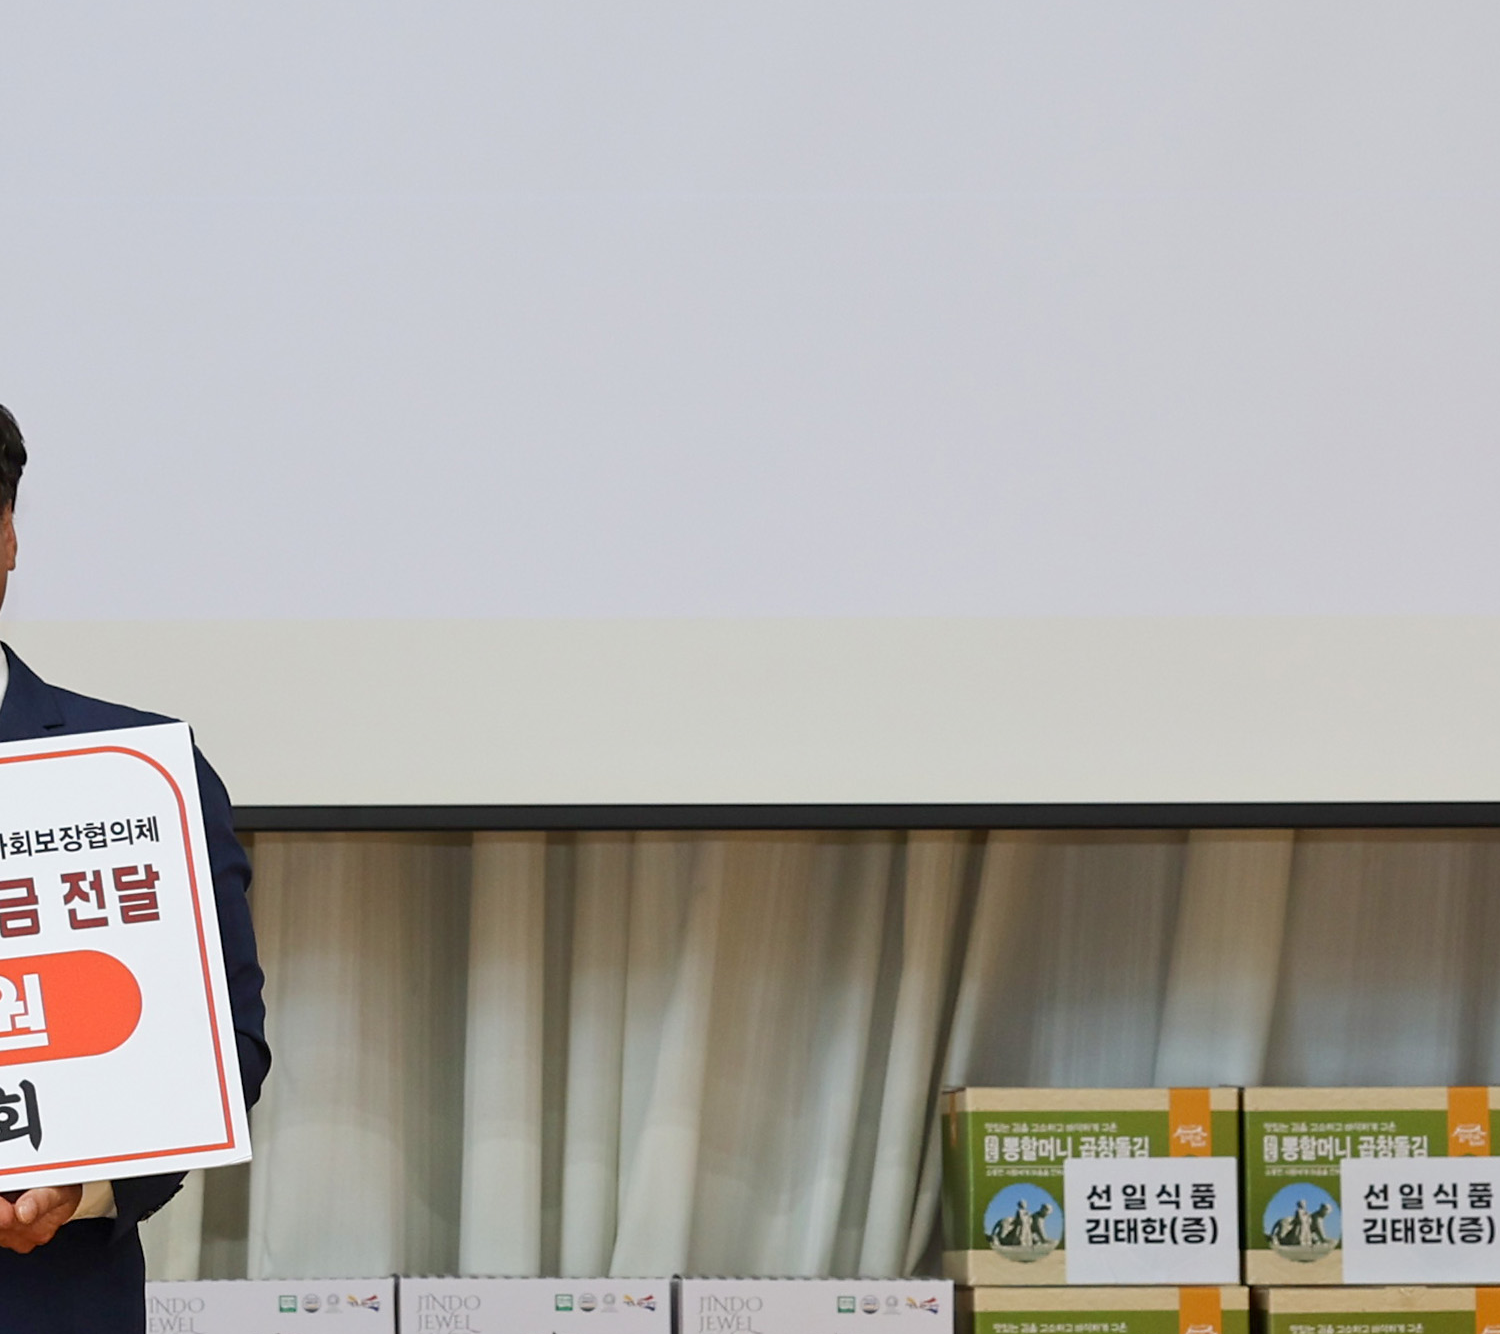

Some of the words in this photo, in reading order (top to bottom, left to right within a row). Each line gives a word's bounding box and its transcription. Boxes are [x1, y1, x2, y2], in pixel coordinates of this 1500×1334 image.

[61, 864, 161, 930] 전달
[1086, 1216, 1217, 1244] 김태한(증)
[1363, 1216, 1495, 1244] 김태한(증)
[417, 1294, 481, 1314] JINDO
[417, 1315, 481, 1333] JEWEL
